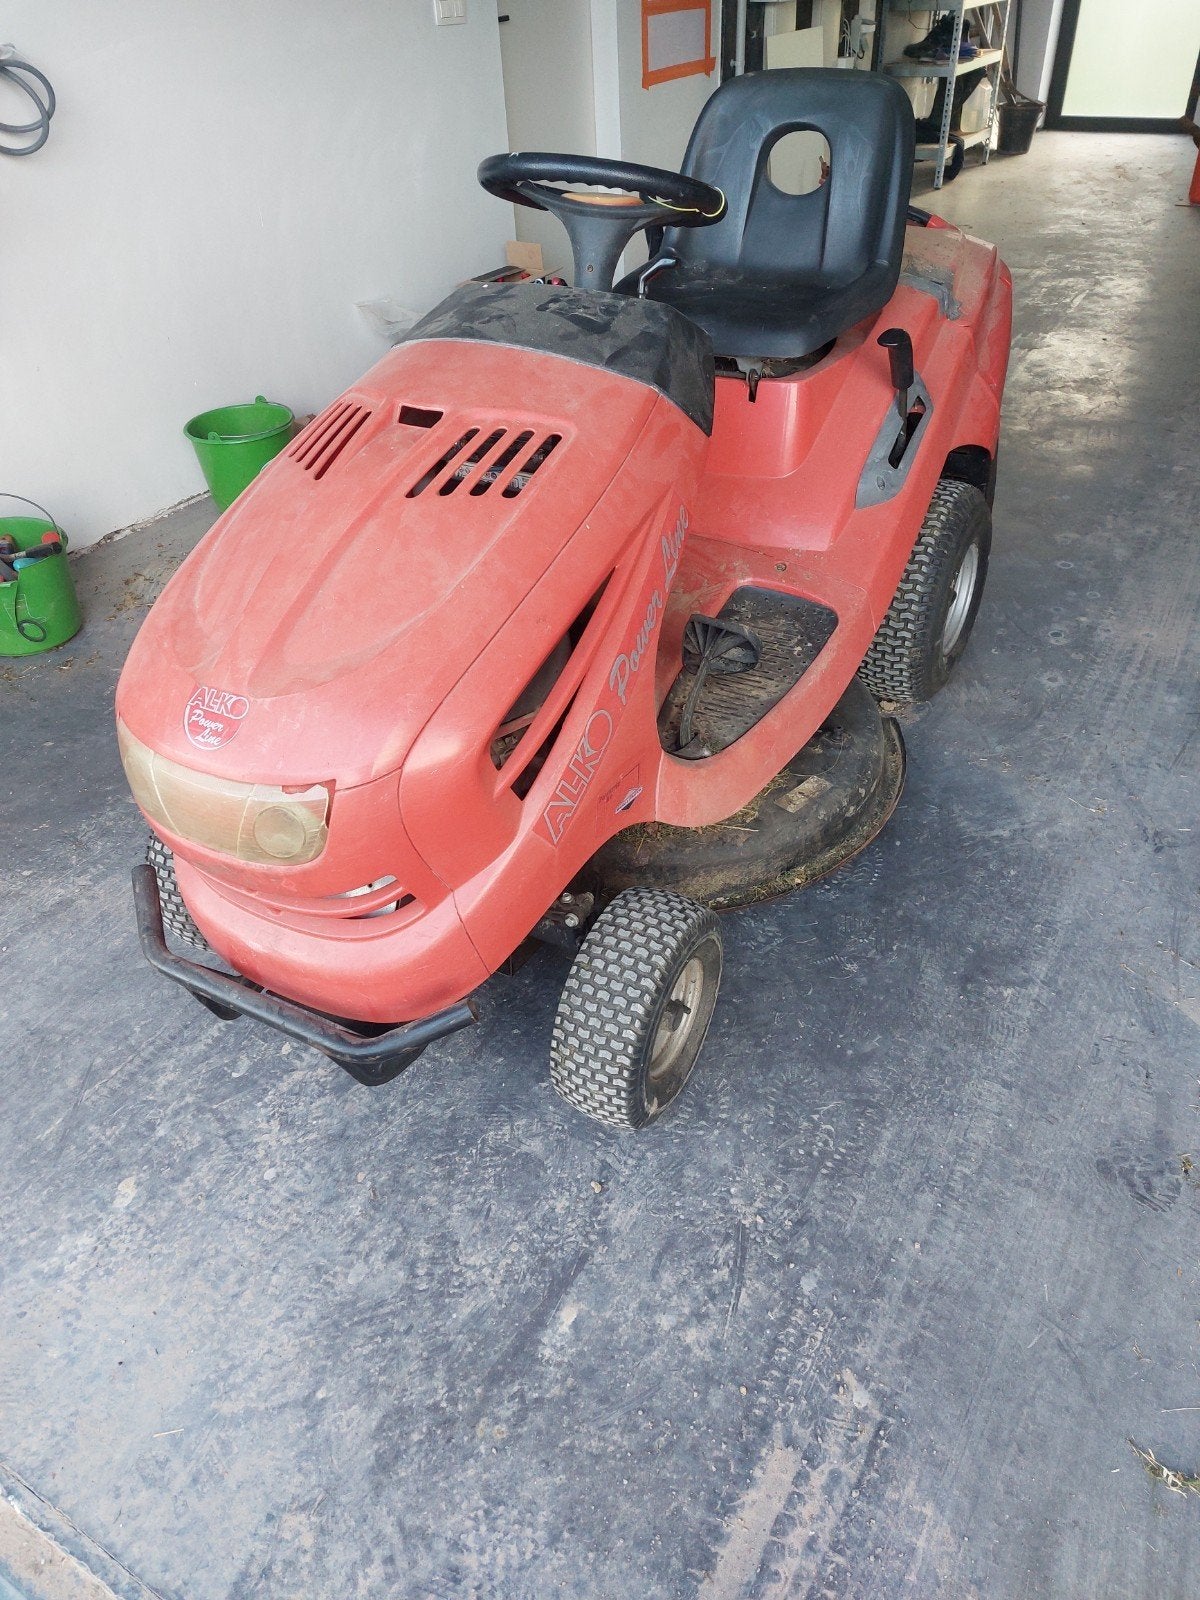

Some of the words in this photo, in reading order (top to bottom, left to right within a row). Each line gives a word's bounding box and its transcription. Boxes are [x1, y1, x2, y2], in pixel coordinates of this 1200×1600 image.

[609, 589, 663, 706] Power
[661, 504, 689, 593] Line
[189, 709, 224, 732] Power
[194, 727, 222, 746] Line
